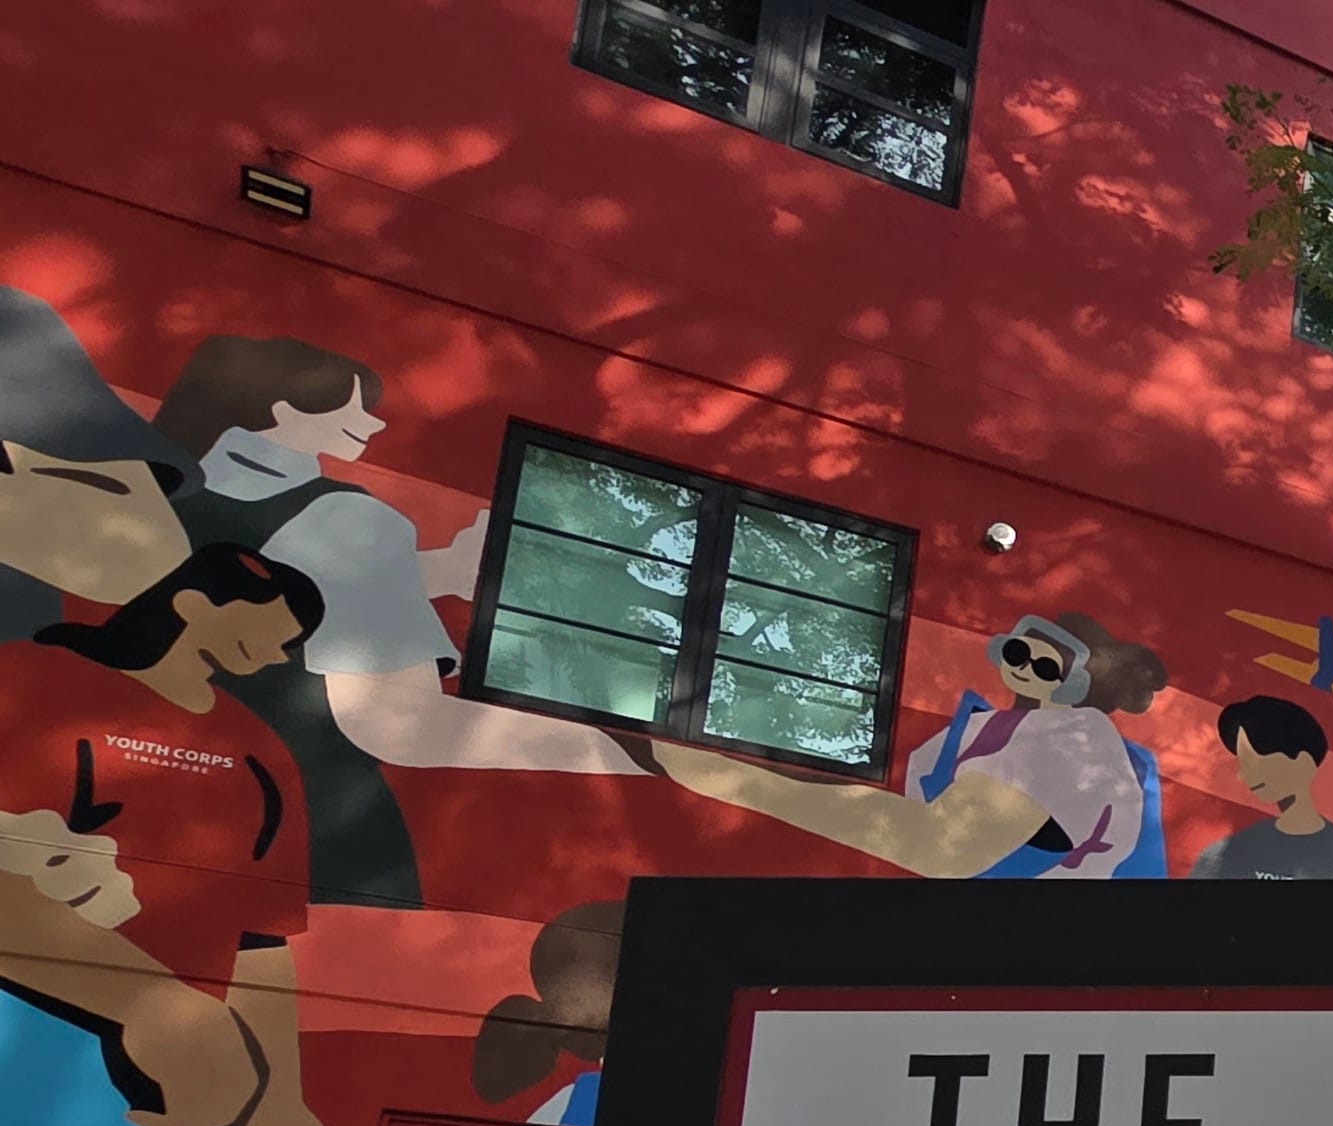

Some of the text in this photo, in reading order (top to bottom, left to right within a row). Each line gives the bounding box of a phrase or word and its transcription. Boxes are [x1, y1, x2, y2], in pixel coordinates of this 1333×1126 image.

[104, 733, 234, 768] YOUTH CORPS
[124, 752, 208, 774] SINGAPORE
